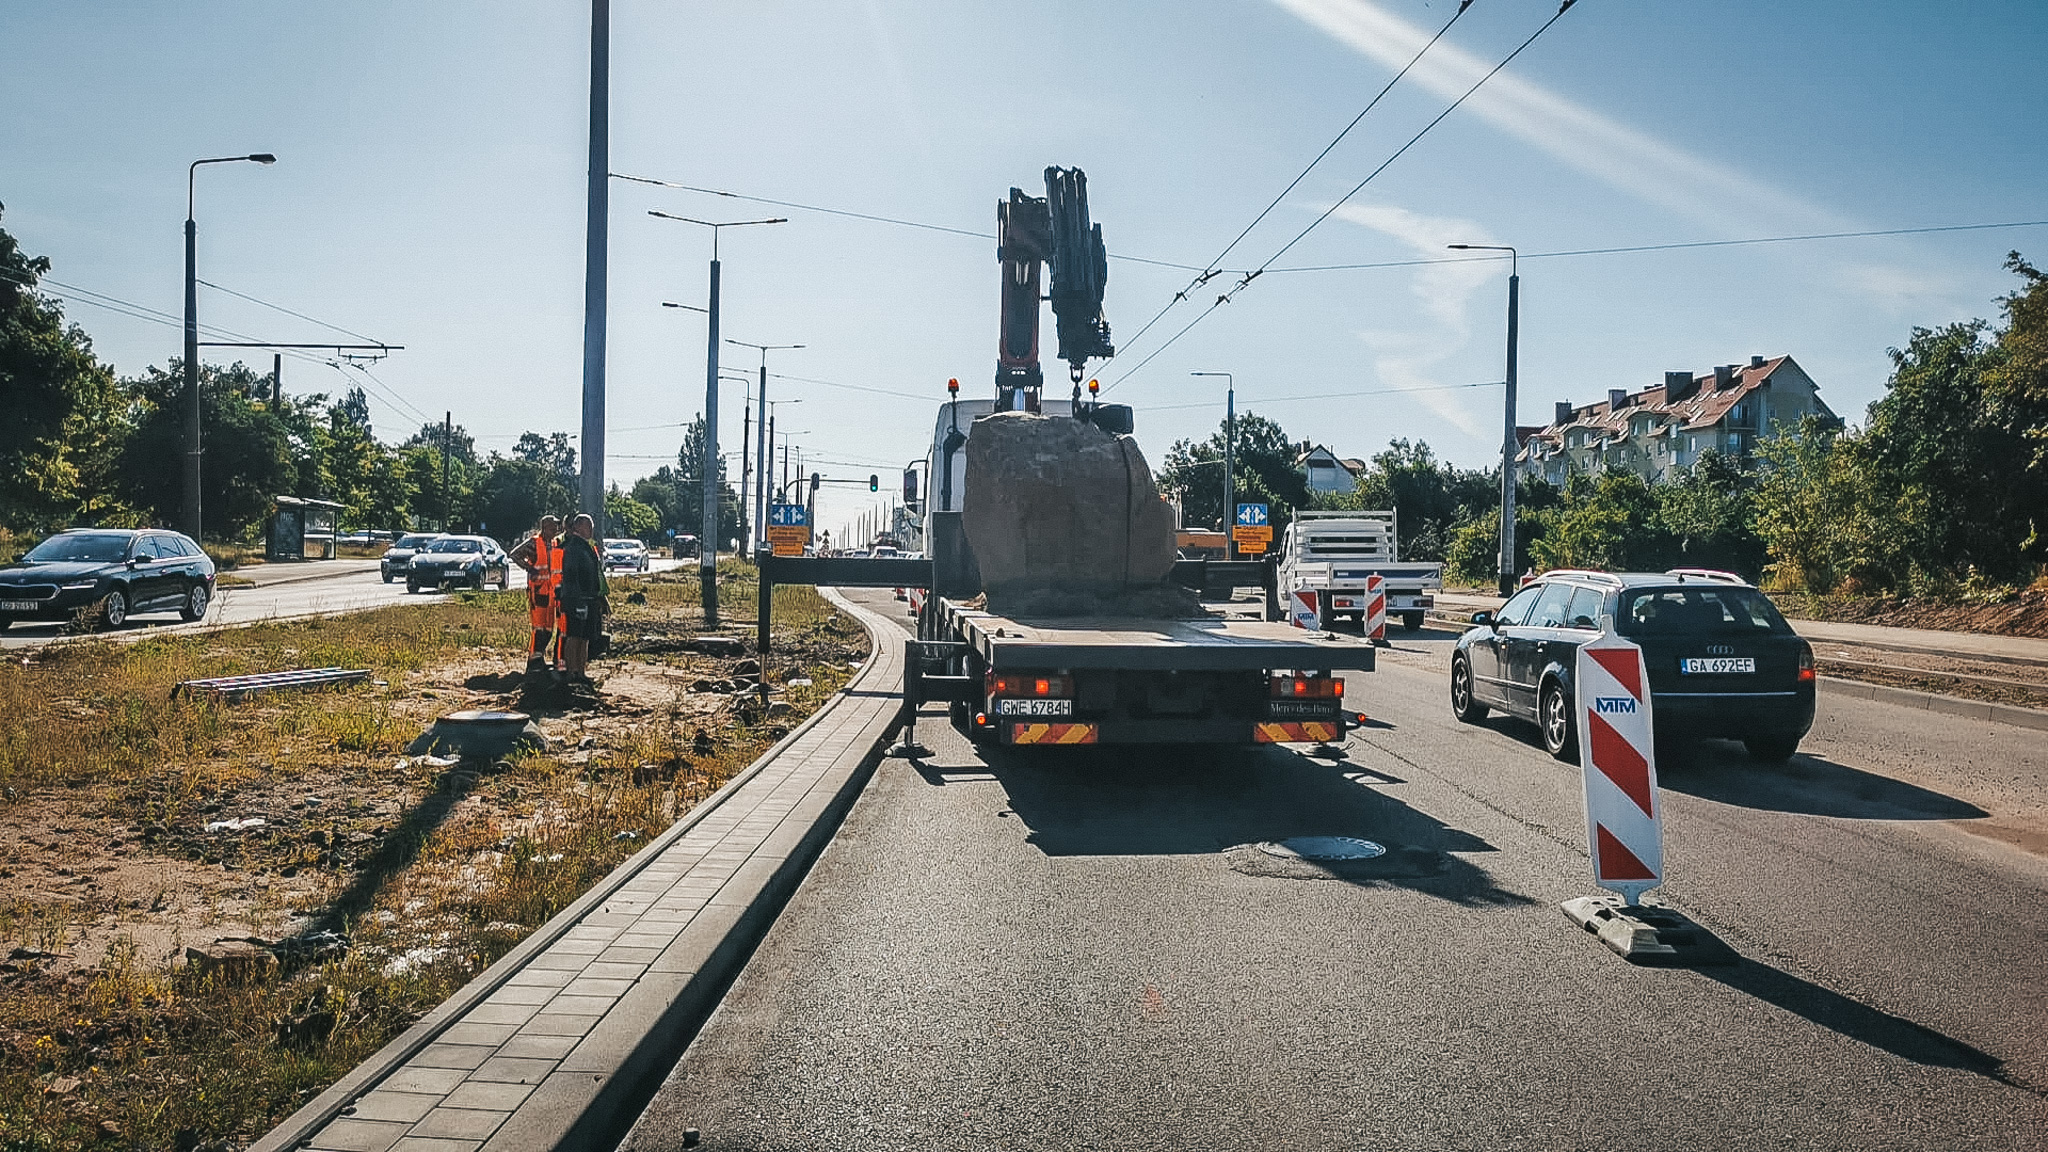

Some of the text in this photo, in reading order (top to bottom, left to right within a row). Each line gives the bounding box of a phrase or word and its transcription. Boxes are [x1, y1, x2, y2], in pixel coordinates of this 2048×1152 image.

[1690, 659, 1752, 672] GA 692EF
[1002, 701, 1071, 715] GWE 6784H
[1596, 698, 1636, 713] MTM
